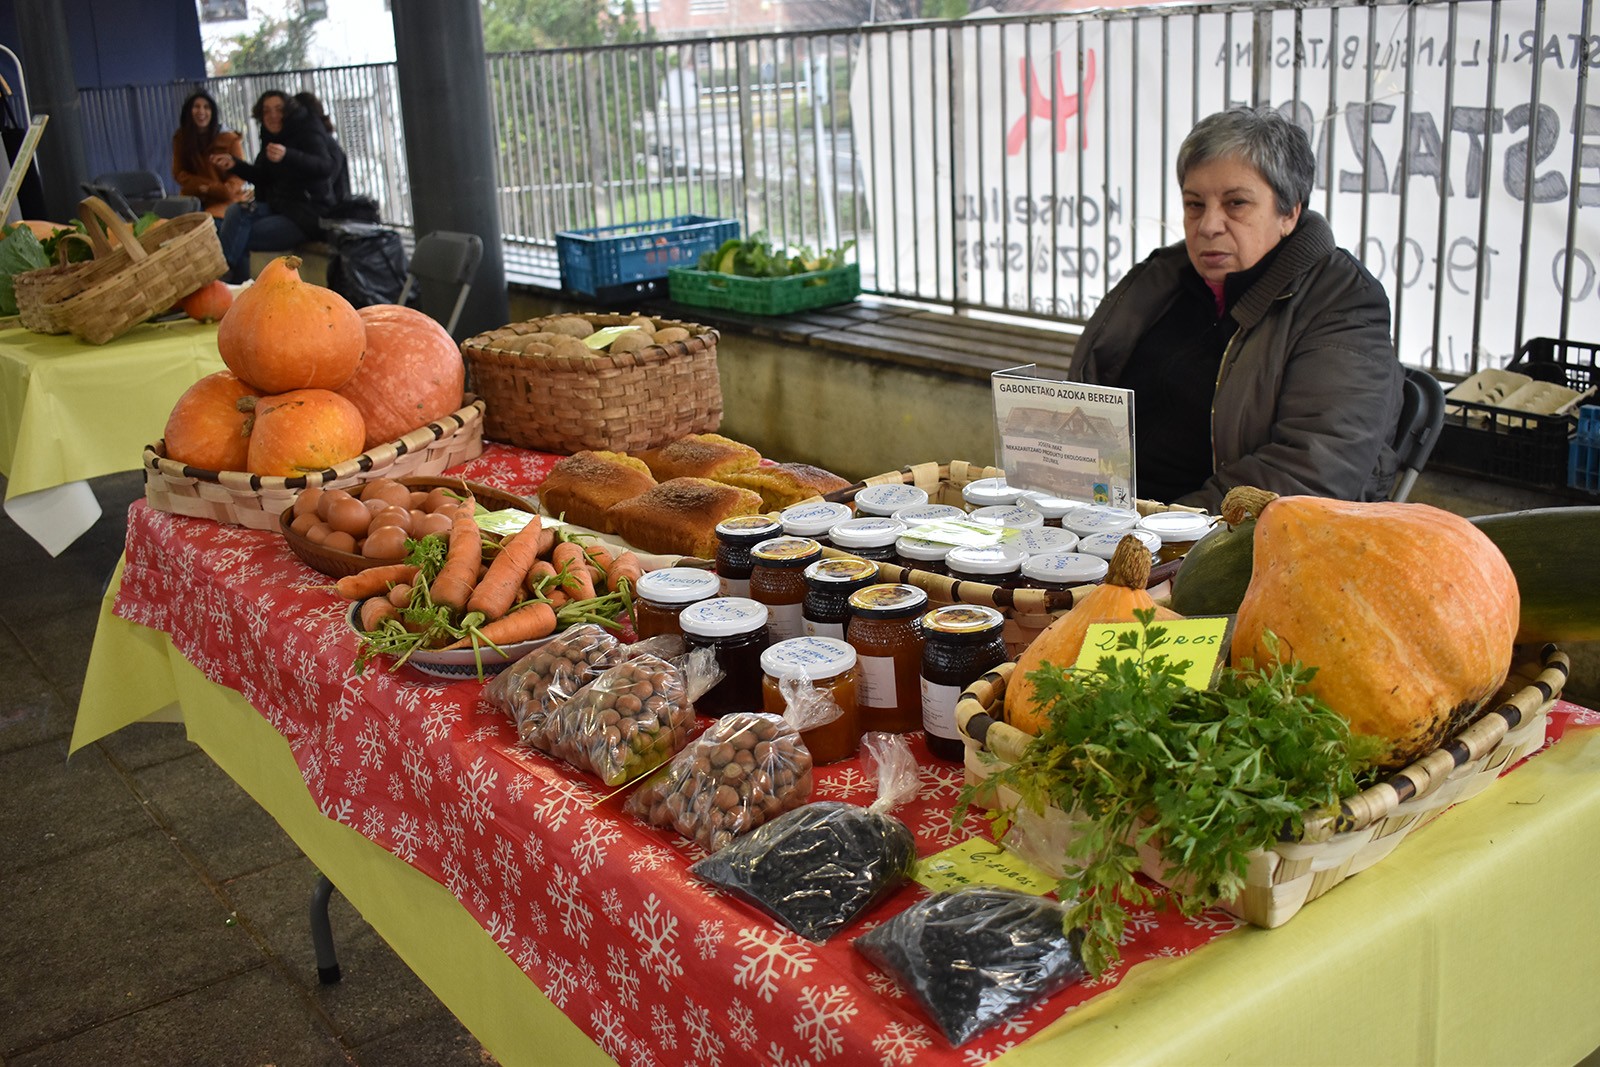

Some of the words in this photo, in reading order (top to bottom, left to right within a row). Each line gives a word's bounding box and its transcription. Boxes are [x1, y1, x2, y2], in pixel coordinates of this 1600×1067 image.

[999, 383, 1055, 397] GABONETAKO
[1057, 389, 1086, 401] AZOKA
[1088, 393, 1123, 405] BEREZIA
[1094, 630, 1116, 650] 2
[1154, 635, 1218, 645] UROS
